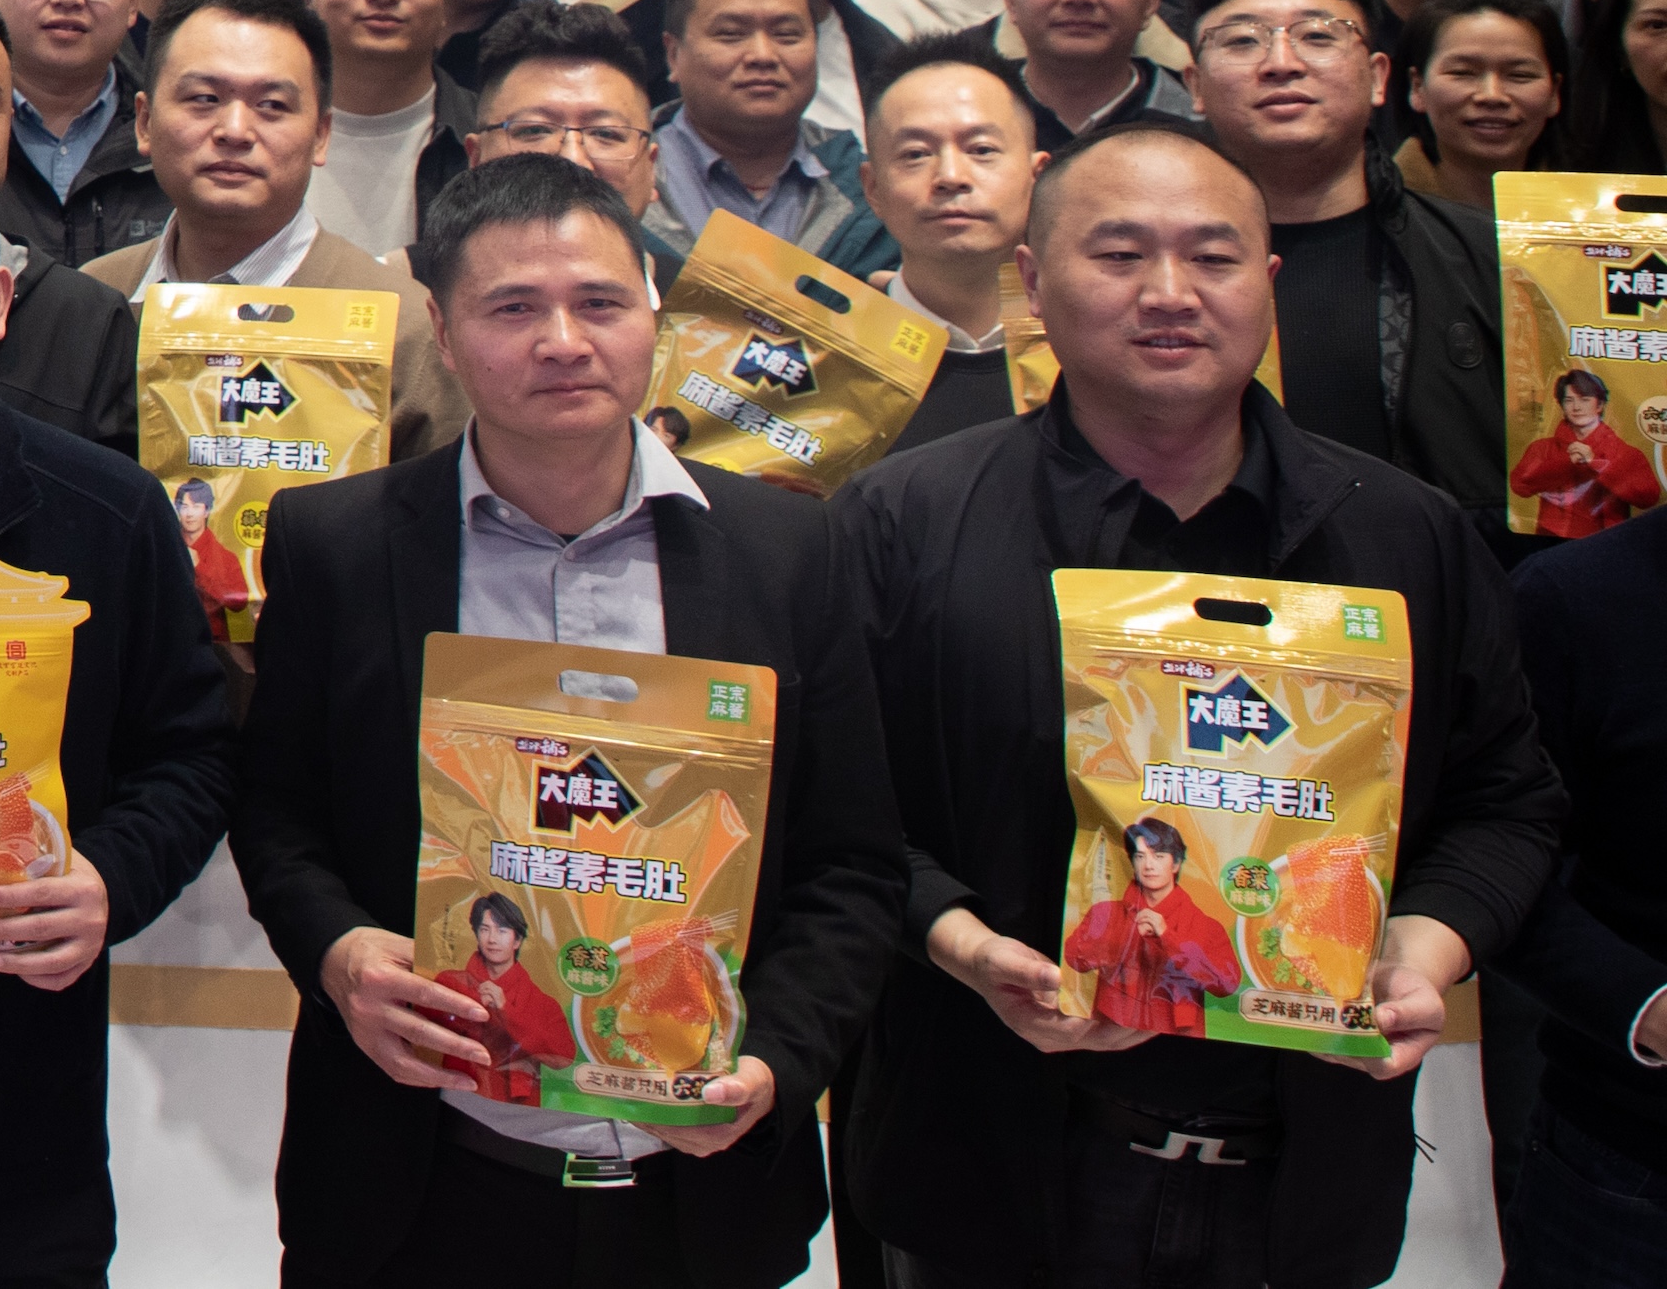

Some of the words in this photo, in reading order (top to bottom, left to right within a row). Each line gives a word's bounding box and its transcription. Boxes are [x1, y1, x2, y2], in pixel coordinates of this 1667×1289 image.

[744, 341, 808, 387] 大魔王
[222, 379, 280, 405] 大魔王
[677, 370, 827, 467] 麻酱素毛肚
[188, 435, 331, 473] 麻酱素毛肚
[1189, 695, 1269, 730] 大魔王
[539, 774, 618, 809] 大魔王
[1142, 764, 1335, 822] 麻酱素毛肚
[489, 841, 687, 904] 麻酱素毛肚
[1252, 997, 1336, 1023] 芝麻酱只用
[586, 1070, 668, 1097] 芝麻酱只用
